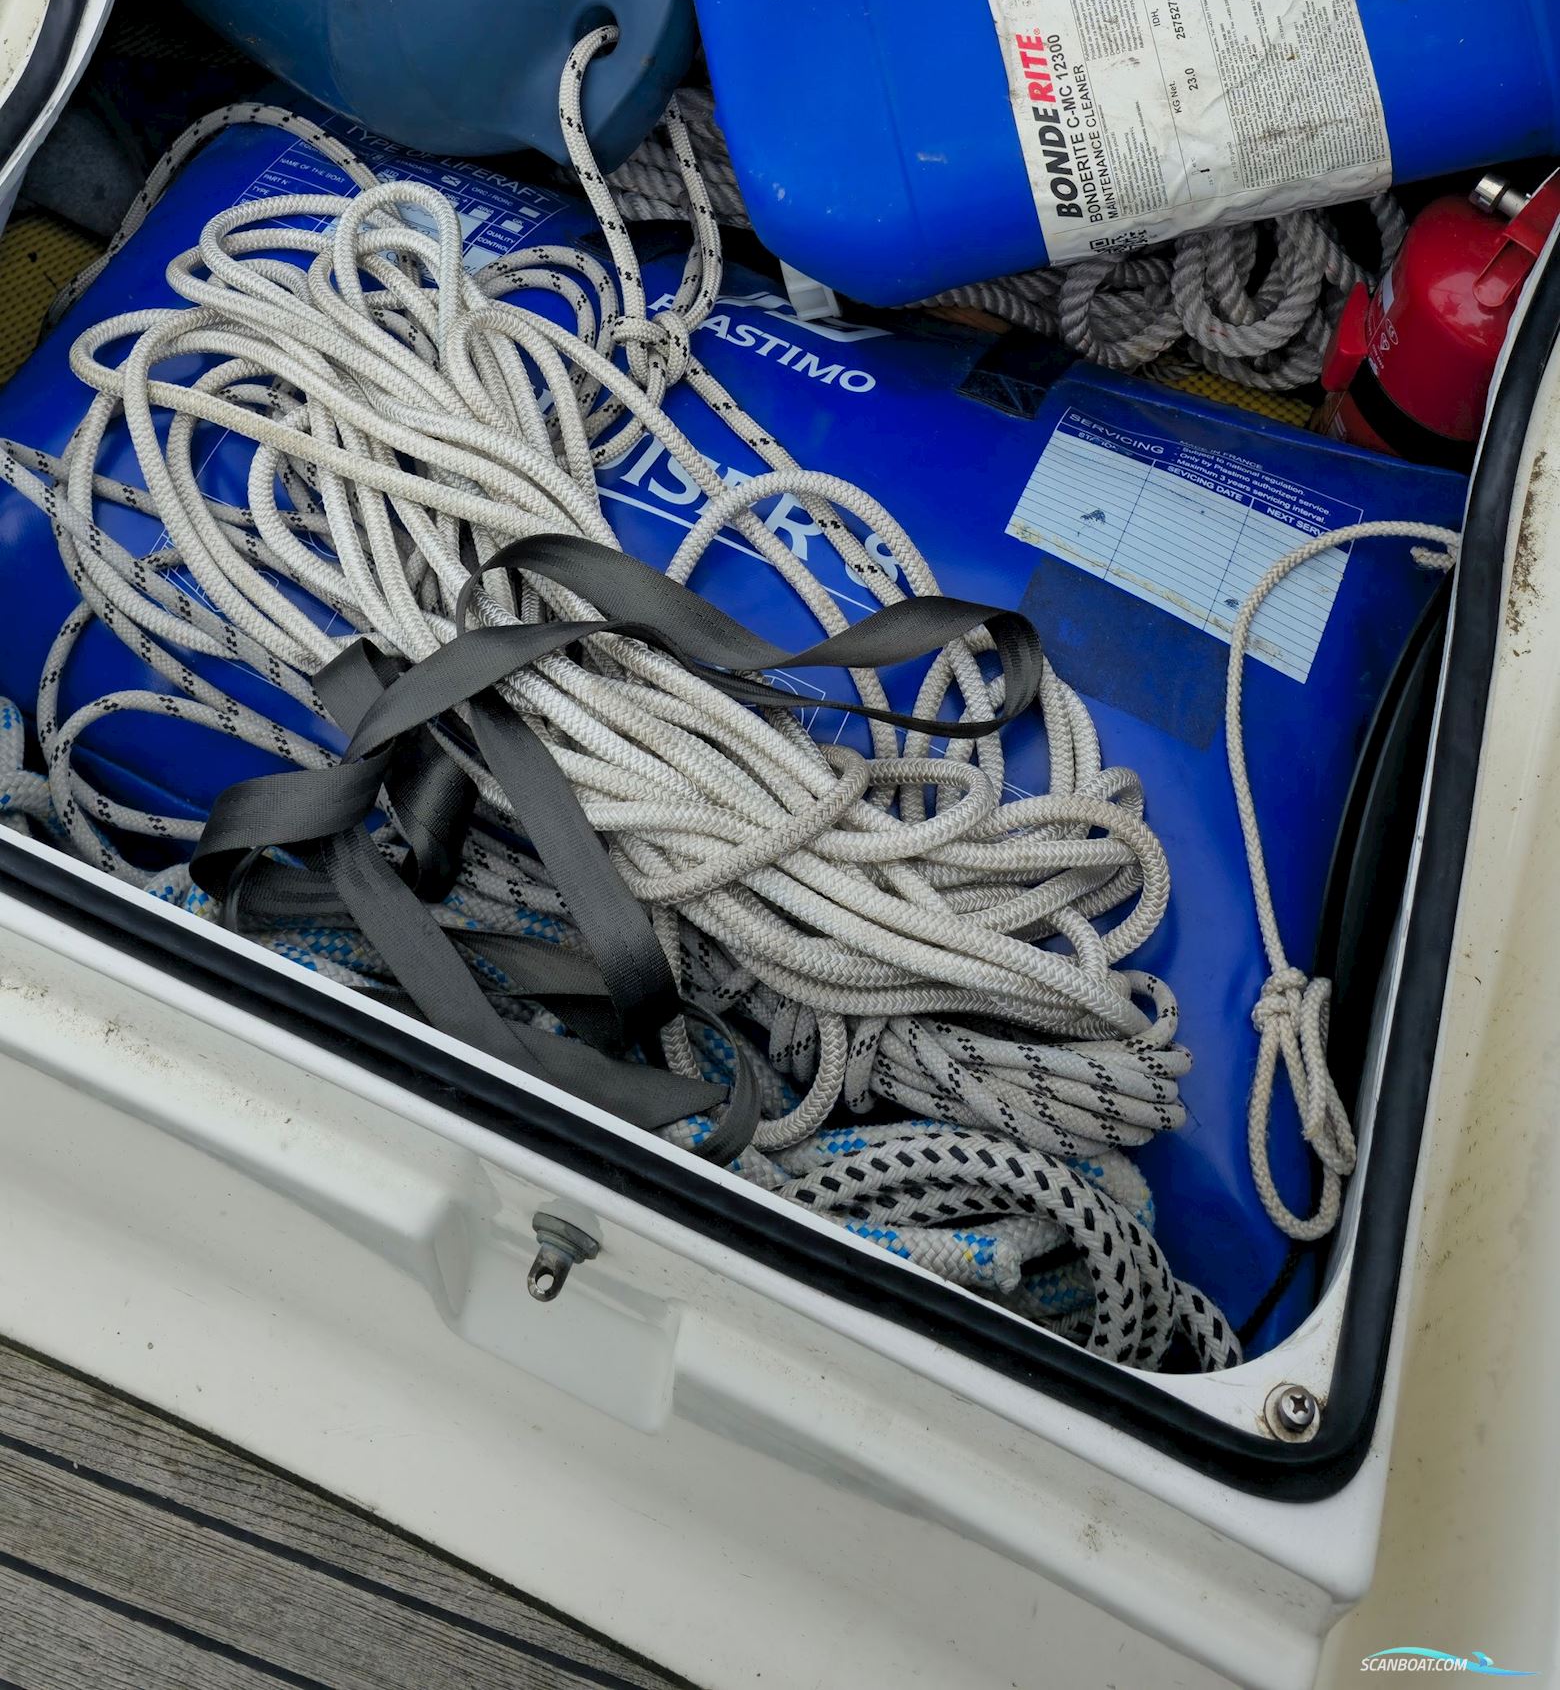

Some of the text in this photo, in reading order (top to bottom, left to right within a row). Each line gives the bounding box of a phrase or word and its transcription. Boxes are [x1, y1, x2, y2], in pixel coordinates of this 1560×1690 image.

[1073, 64, 1097, 128] CLEANER
[1169, 83, 1182, 113] KG Net.
[1184, 68, 1199, 91] 23.0
[1016, 34, 1084, 218] BONDERITE
[1047, 34, 1103, 223] BONDERITE C-MC 12300
[262, 172, 282, 184] PART
[279, 158, 345, 183] NAME OF THE BOAT
[346, 124, 408, 153] TYPE
[440, 158, 550, 203] LIFERAFT
[1089, 131, 1119, 219] MAINTENANCE
[252, 186, 270, 195] TYPE
[476, 235, 508, 252] CONTROL
[486, 230, 515, 244] QUALITY
[648, 293, 876, 392] PASTIMO
[1069, 414, 1164, 454] SERVICING
[1167, 466, 1243, 501] SEVICING DATE
[1177, 459, 1324, 523] Maximum 3 years servicing interval.
[1178, 450, 1329, 515] Only by Plastimo authorized service.
[1214, 455, 1225, 465] to
[1226, 462, 1260, 477] national
[1261, 475, 1304, 495] regulation.
[1267, 507, 1325, 538] NEXT SERV
